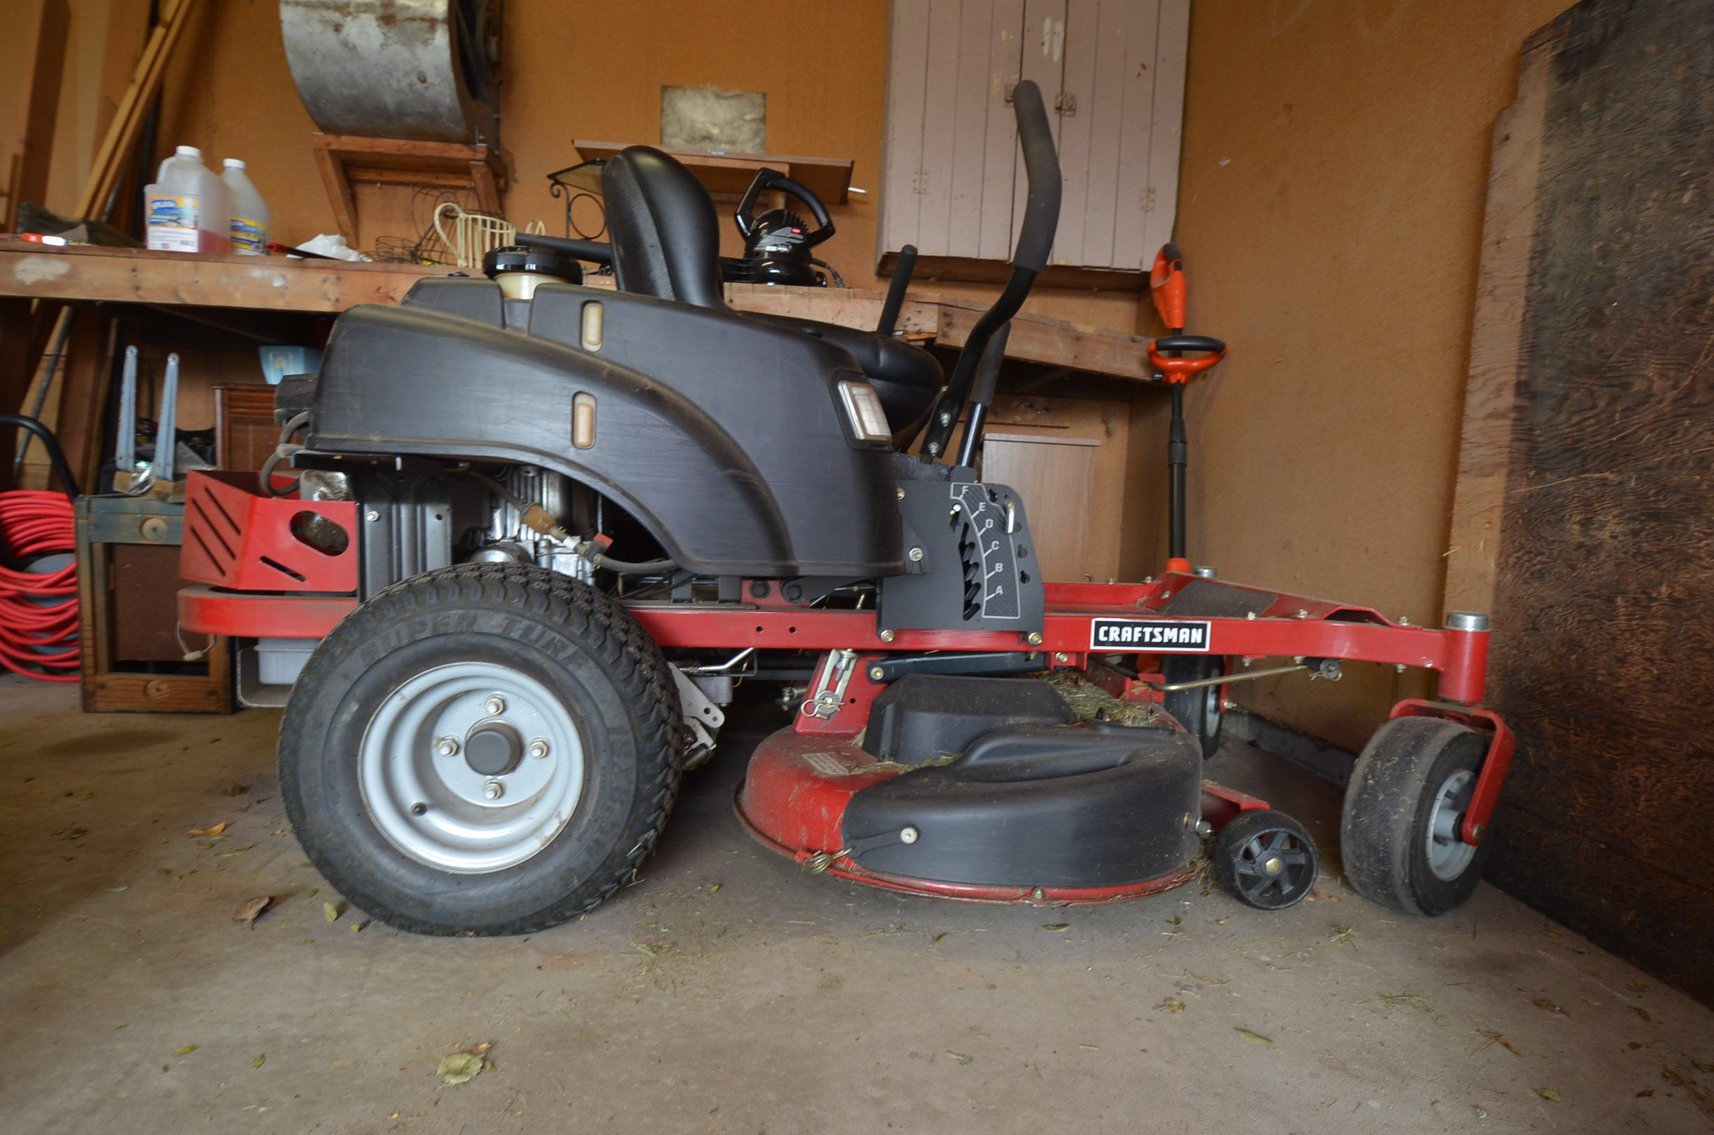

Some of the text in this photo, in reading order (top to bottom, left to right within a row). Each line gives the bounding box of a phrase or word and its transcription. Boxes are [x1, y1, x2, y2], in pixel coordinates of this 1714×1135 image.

[961, 485, 969, 495] F
[979, 502, 986, 511] E
[985, 518, 994, 529] D
[991, 540, 1000, 551] C
[995, 562, 1003, 572] B
[995, 585, 1004, 595] A
[1098, 625, 1202, 644] CRAFTSMAN
